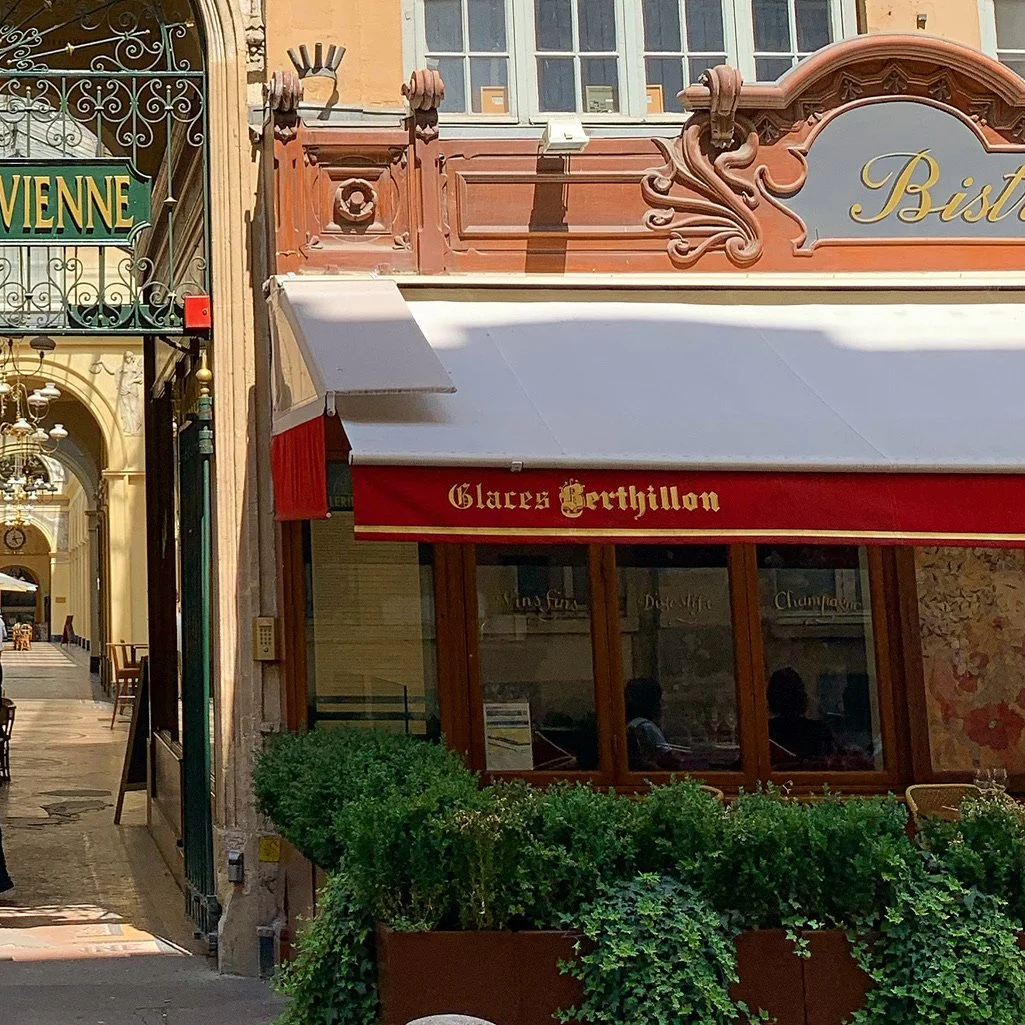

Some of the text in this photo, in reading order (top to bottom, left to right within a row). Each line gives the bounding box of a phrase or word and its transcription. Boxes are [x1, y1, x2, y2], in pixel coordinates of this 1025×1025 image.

[849, 148, 1025, 223] Bist
[448, 478, 720, 520] Glaces Berthillon
[774, 591, 863, 615] Champagne
